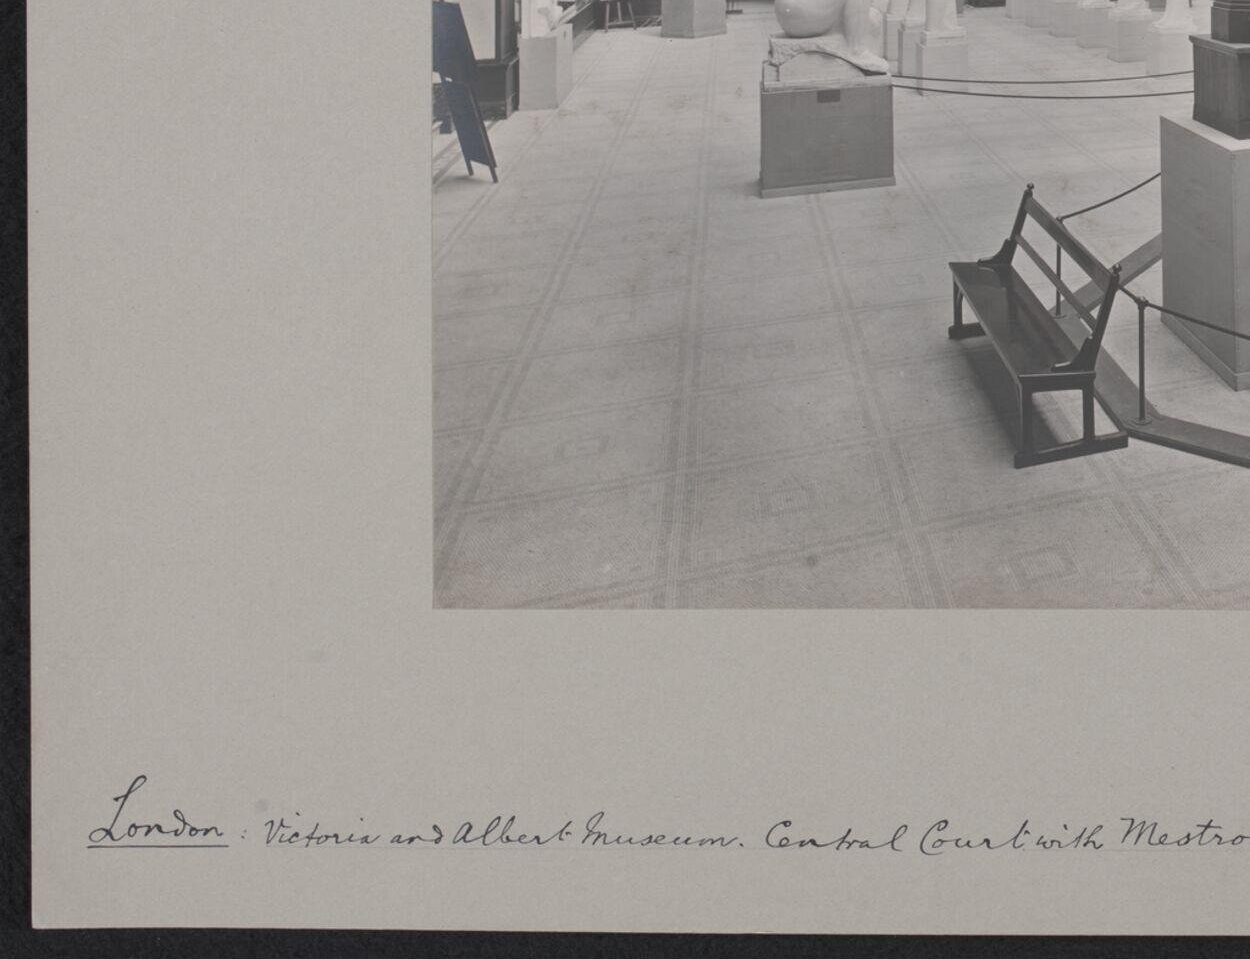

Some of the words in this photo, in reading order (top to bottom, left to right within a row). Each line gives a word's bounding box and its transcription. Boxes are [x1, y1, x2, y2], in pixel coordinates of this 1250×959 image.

[264, 811, 381, 848] Victoria
[390, 824, 445, 845] and
[452, 816, 573, 847] Albert
[581, 810, 745, 848] Museum.
[764, 819, 909, 852] Central
[919, 818, 1031, 856] Court
[1035, 823, 1105, 851] with
